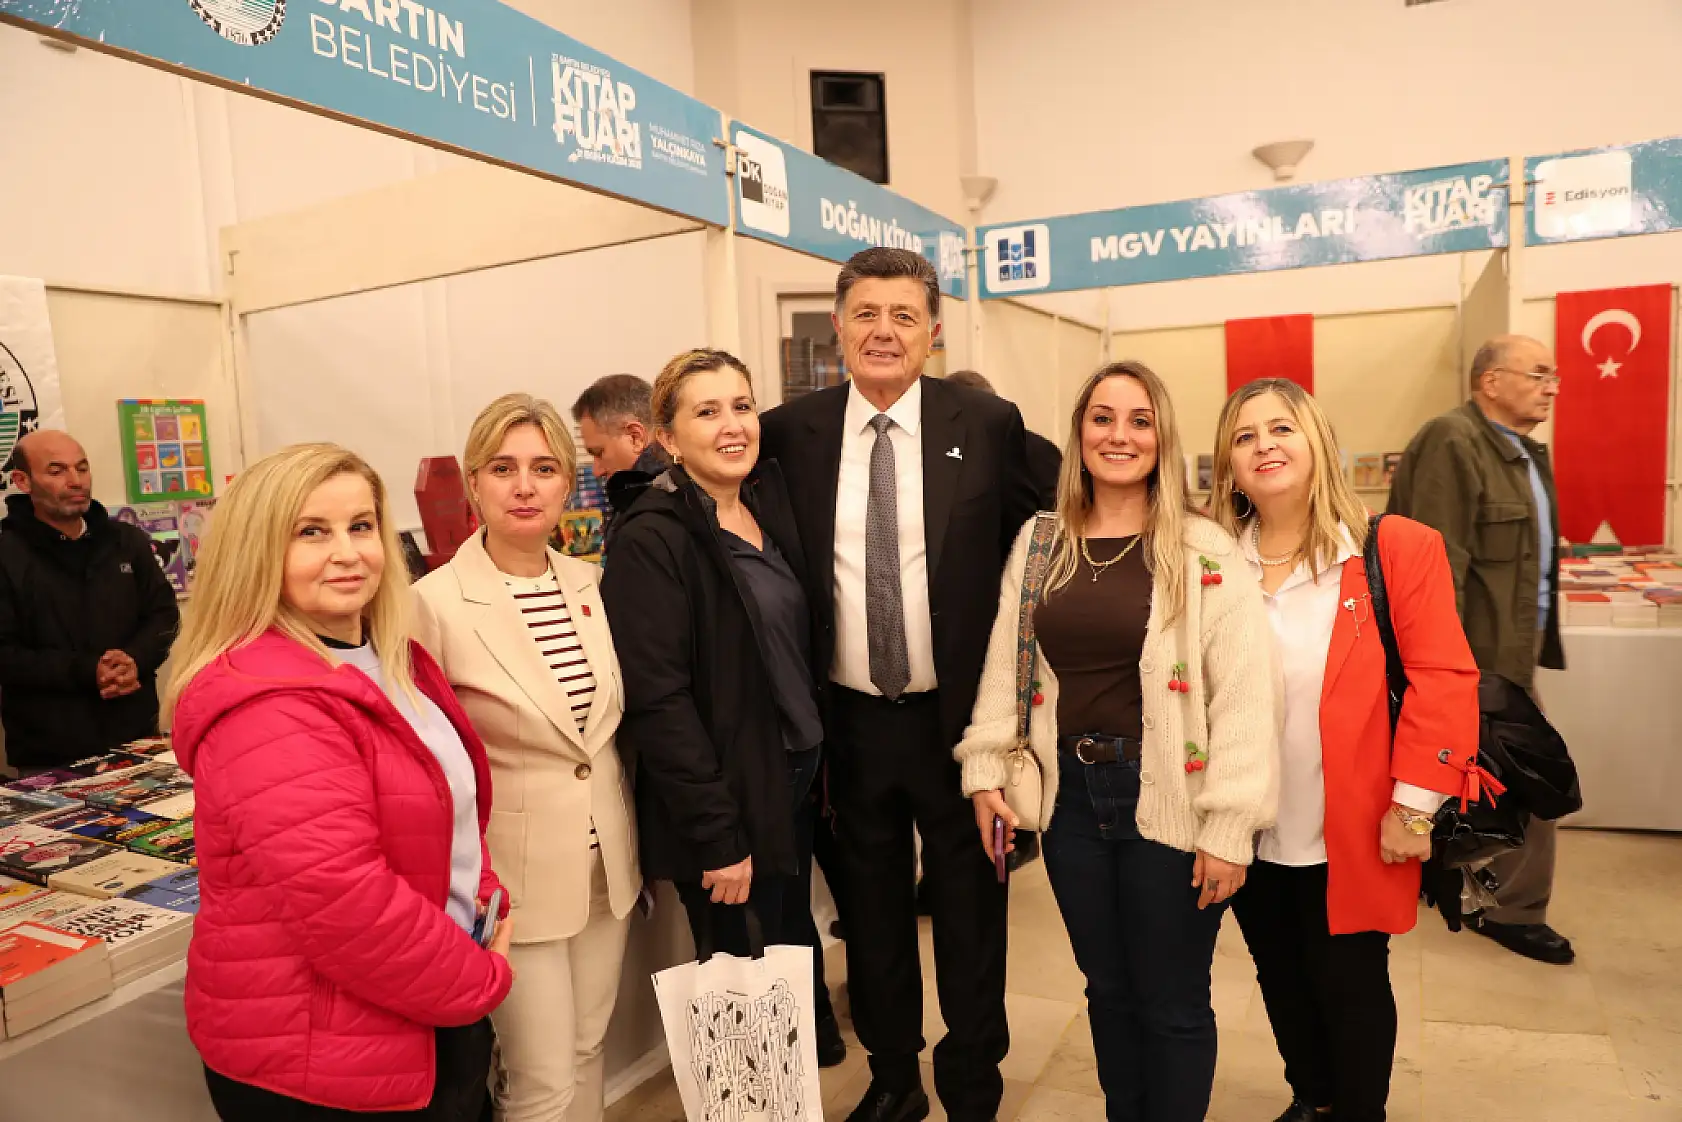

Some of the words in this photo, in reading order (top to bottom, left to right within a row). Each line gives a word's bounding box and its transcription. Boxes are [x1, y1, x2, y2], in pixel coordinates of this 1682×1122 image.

[318, 0, 465, 58] RTIN
[310, 13, 516, 122] BELEDİYESİ
[552, 61, 636, 122] KİTAP
[553, 103, 642, 159] FUARI
[1565, 185, 1629, 202] Edisyon
[820, 197, 882, 247] DOĞAN
[1090, 228, 1165, 262] MGV
[1169, 207, 1355, 253] YAYINLARI
